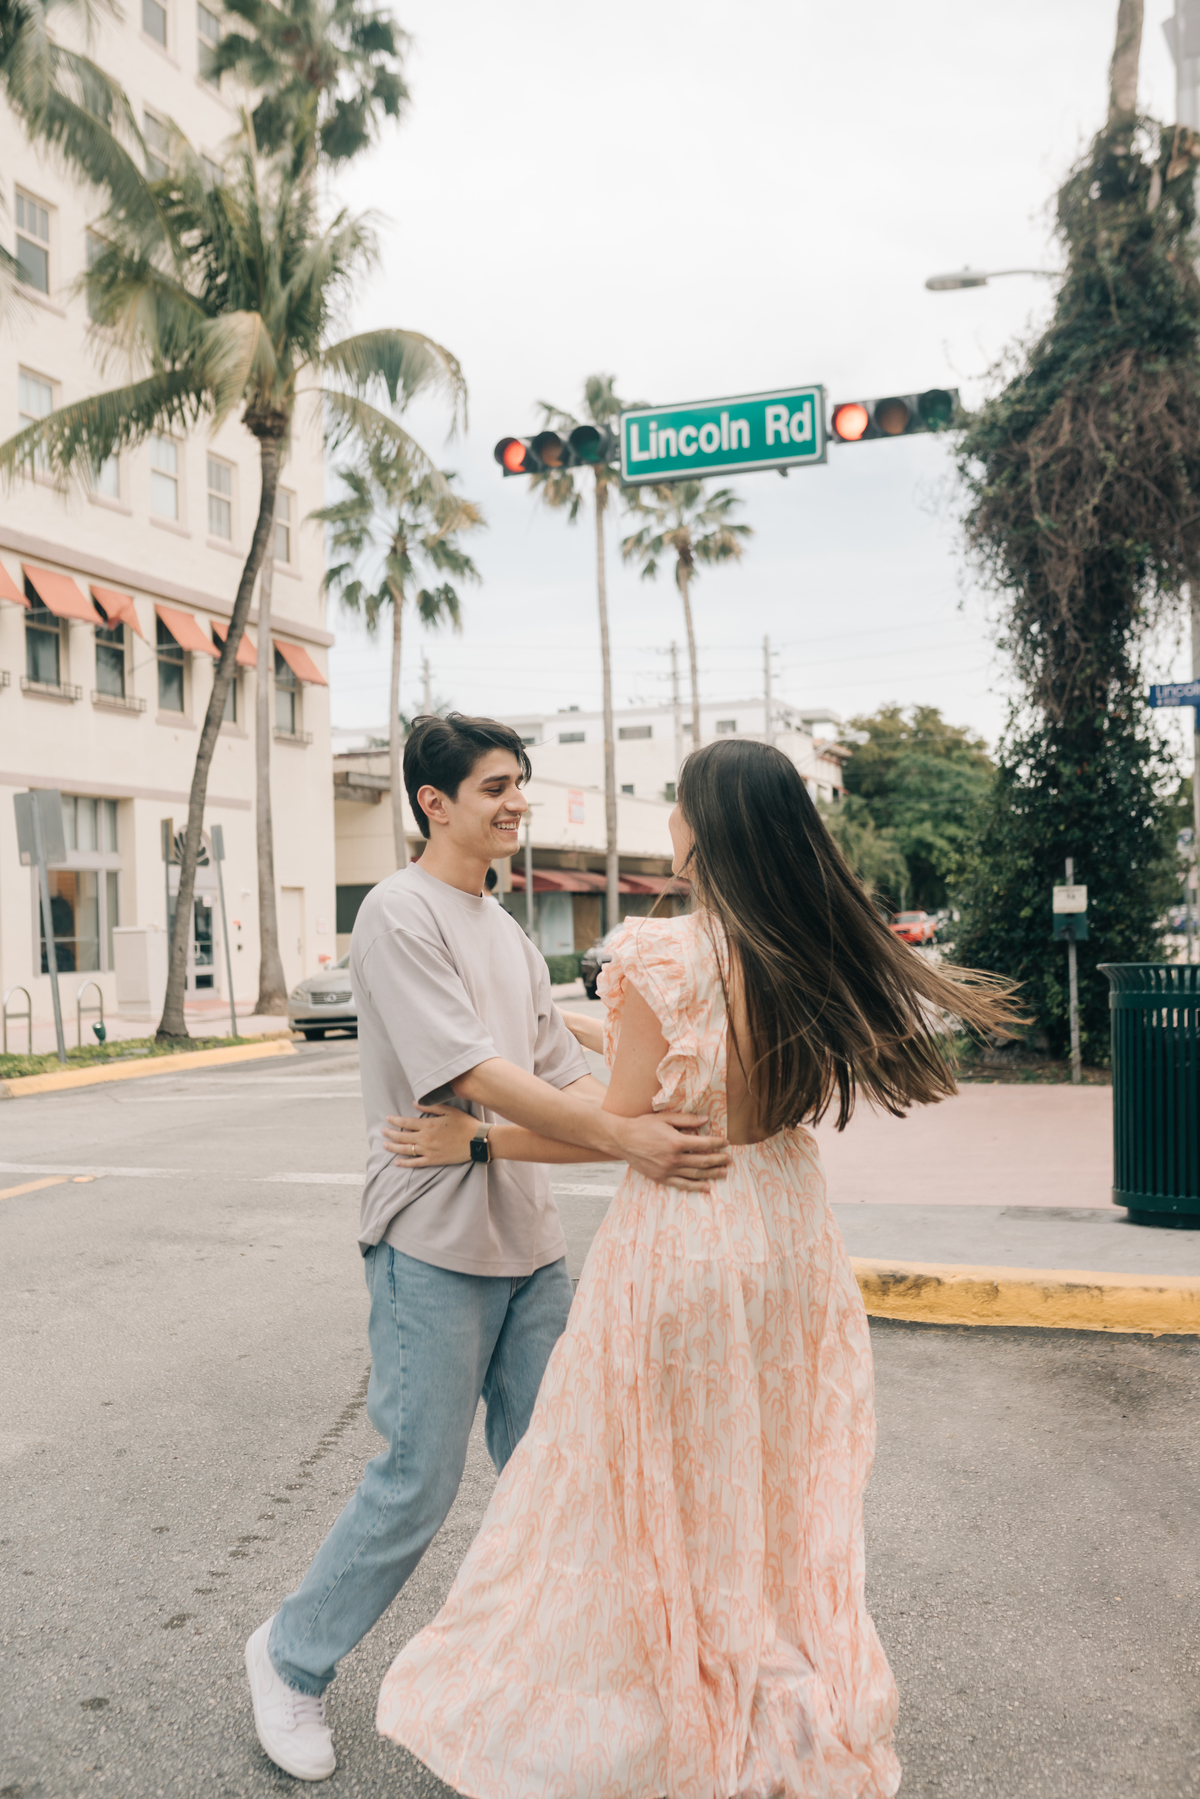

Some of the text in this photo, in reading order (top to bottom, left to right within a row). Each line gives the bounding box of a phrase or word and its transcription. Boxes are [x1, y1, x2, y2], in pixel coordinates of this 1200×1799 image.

[629, 400, 813, 463] Lincoln Rd
[1155, 683, 1200, 699] Lincol
